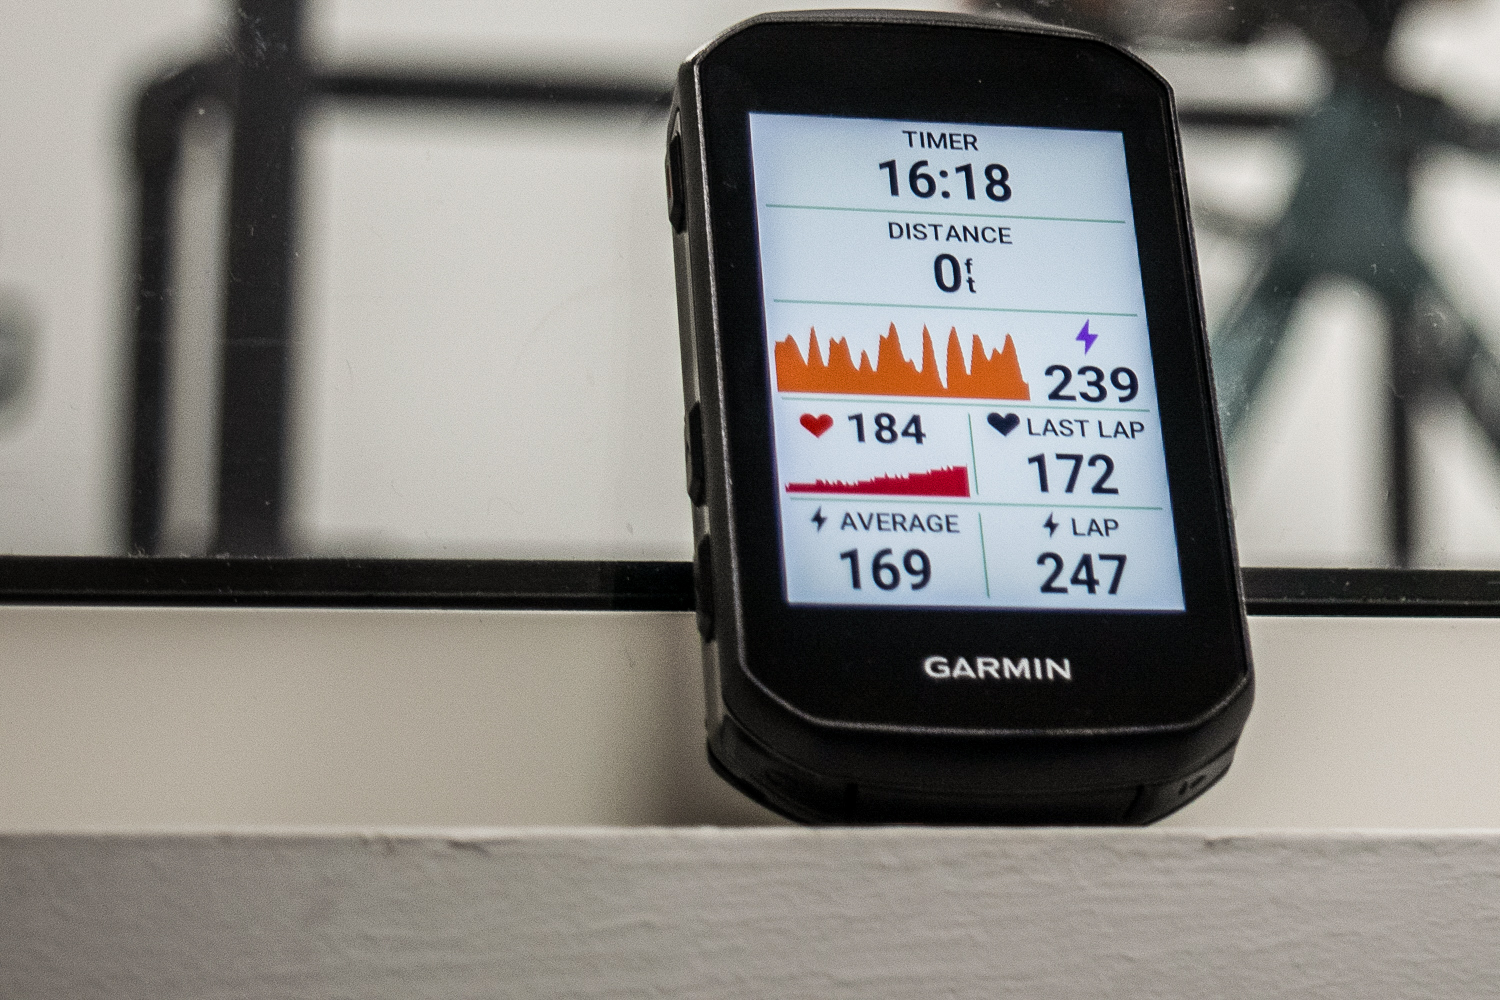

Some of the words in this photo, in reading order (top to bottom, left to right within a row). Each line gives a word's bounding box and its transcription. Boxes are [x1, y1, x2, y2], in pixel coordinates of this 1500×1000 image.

[902, 130, 979, 152] TIMER
[878, 159, 1013, 202] 16:18
[888, 221, 1013, 245] DISTANCE
[1043, 364, 1140, 403] 239
[847, 412, 927, 445] 184
[1026, 417, 1090, 439] LAST
[1098, 419, 1146, 440] LAP
[1027, 452, 1120, 496] 172
[840, 511, 961, 534] AVERAGE
[1071, 517, 1120, 538] LAP
[839, 547, 933, 591] 169
[1036, 551, 1128, 596] 247
[923, 655, 1073, 681] GARMIN
